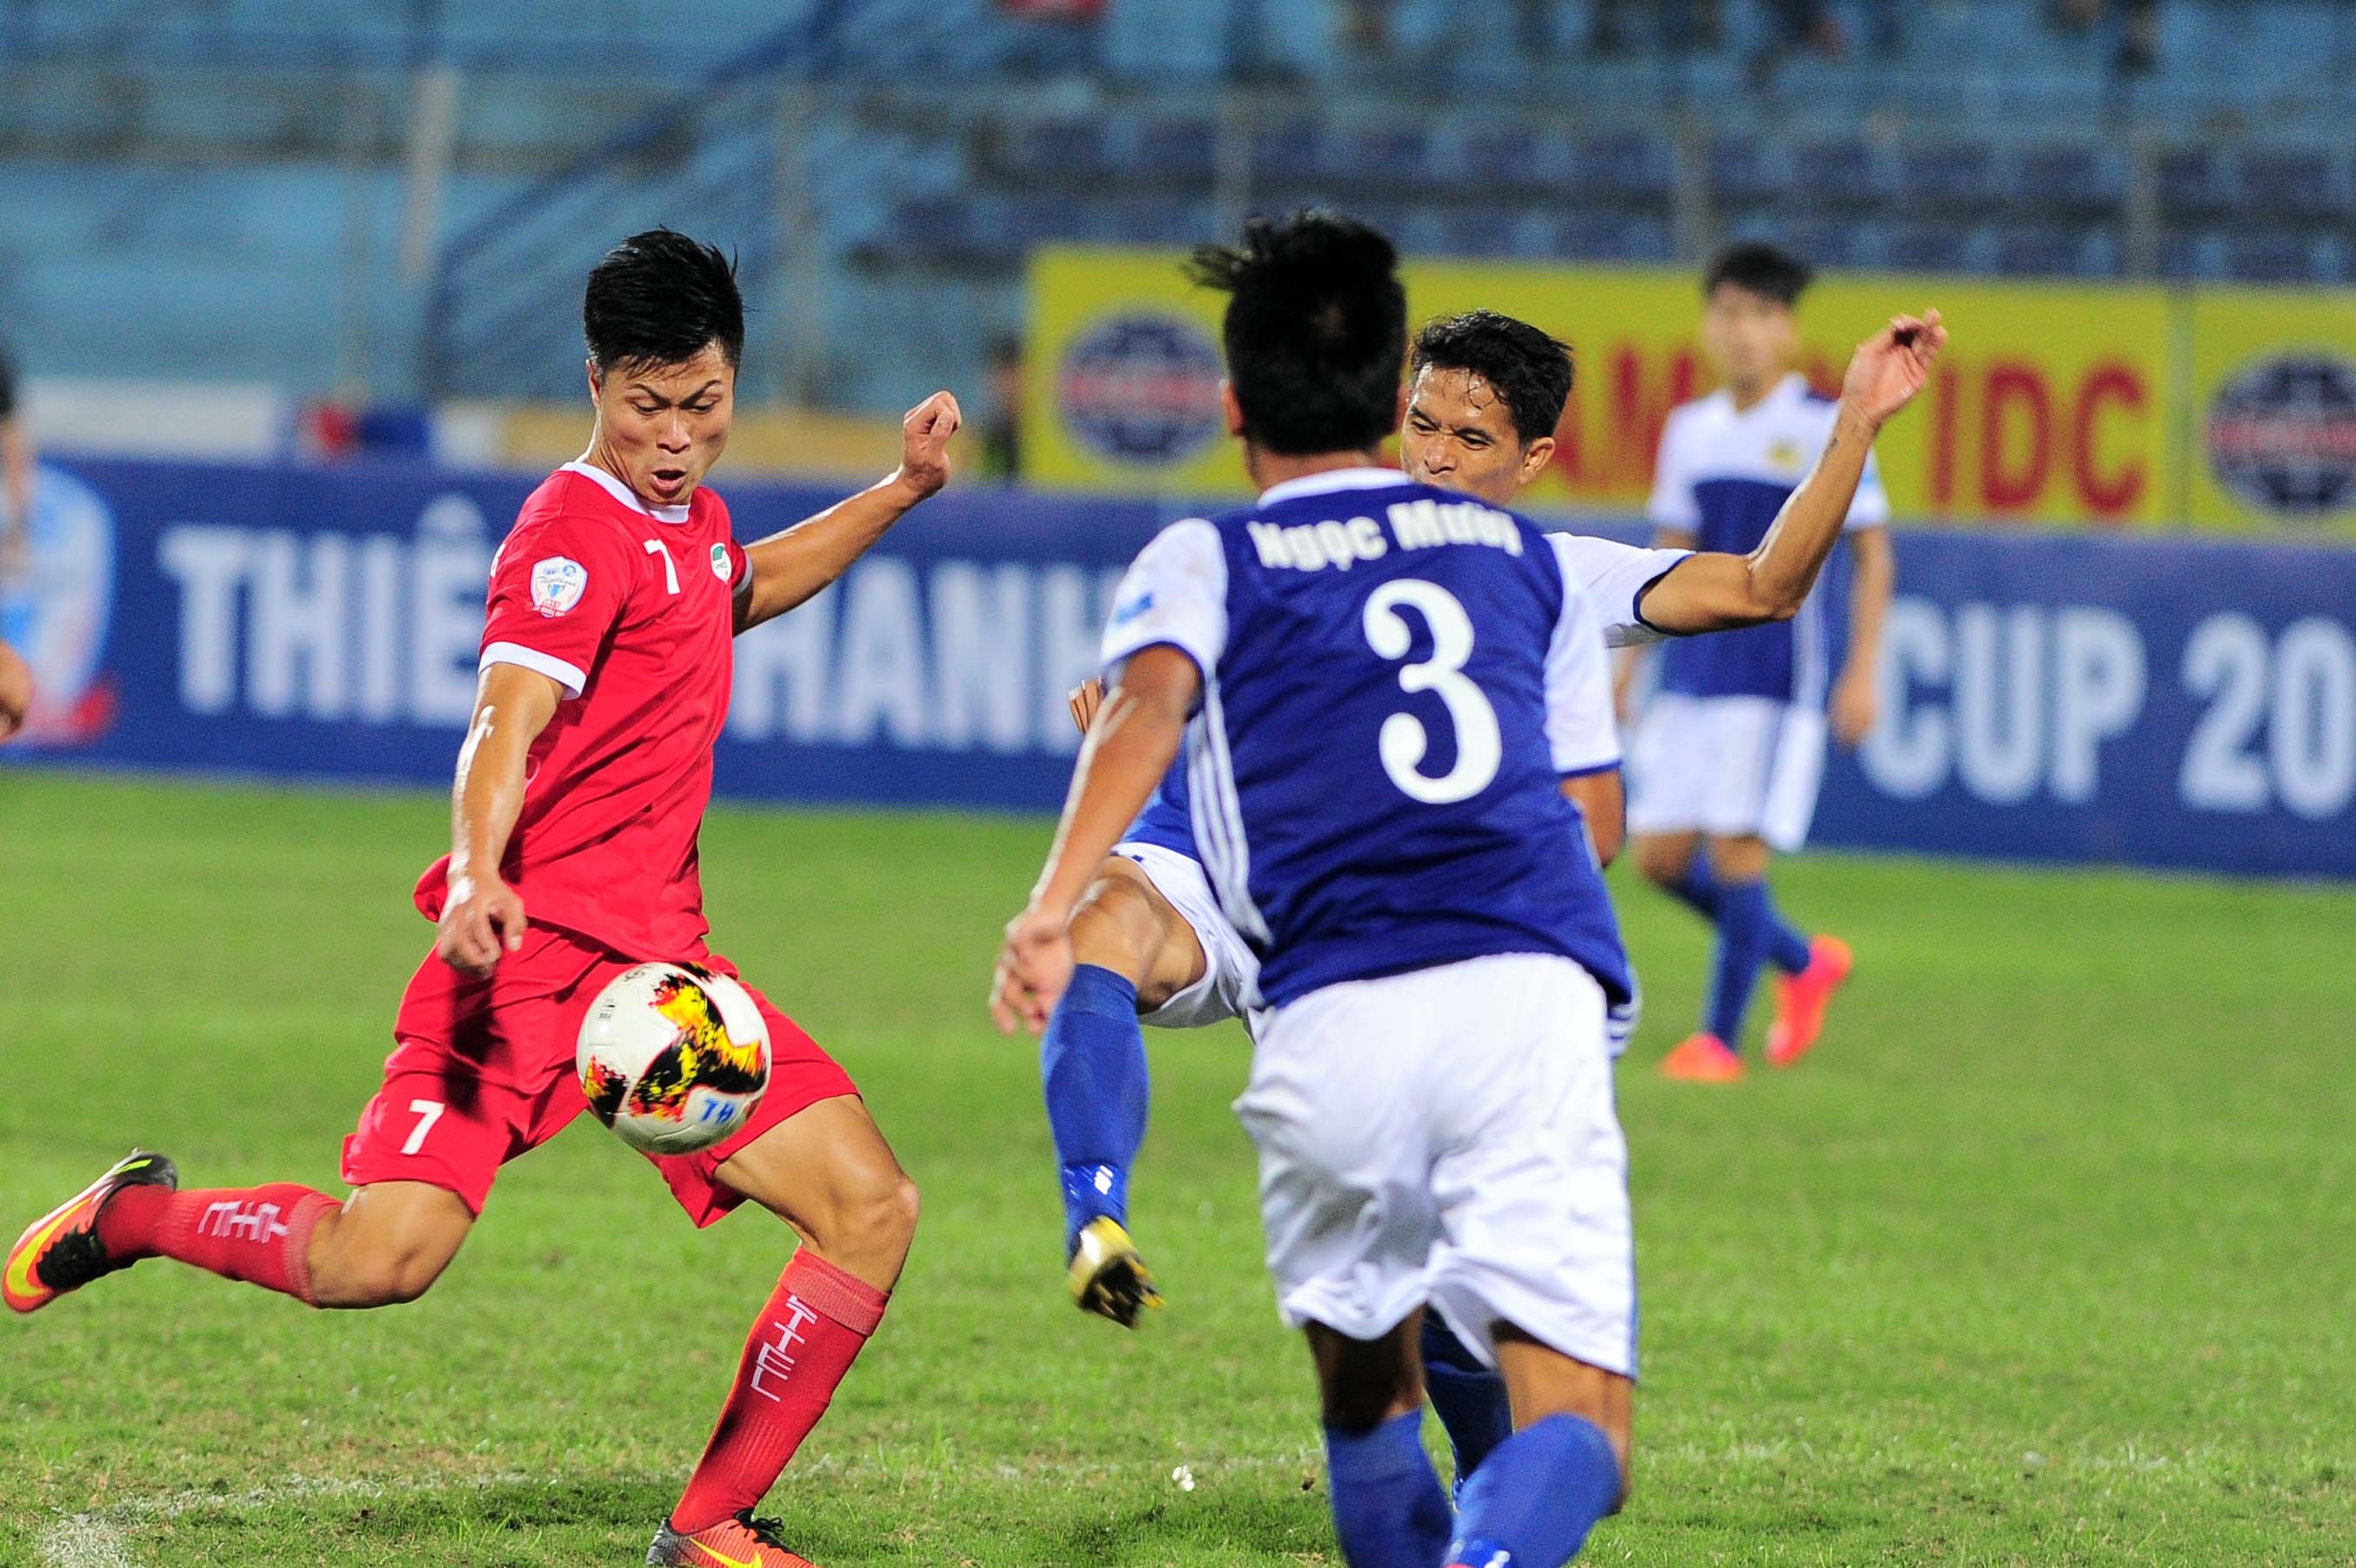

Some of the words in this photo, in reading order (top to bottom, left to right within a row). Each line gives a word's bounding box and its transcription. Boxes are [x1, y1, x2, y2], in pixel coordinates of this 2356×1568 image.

[1928, 358, 2148, 518] IDC
[644, 539, 681, 595] 7
[158, 490, 491, 725] THIÊ
[1861, 595, 2145, 805] CUP
[2181, 614, 2356, 819] 20
[1362, 578, 1503, 804] 3
[401, 1099, 444, 1155] 7
